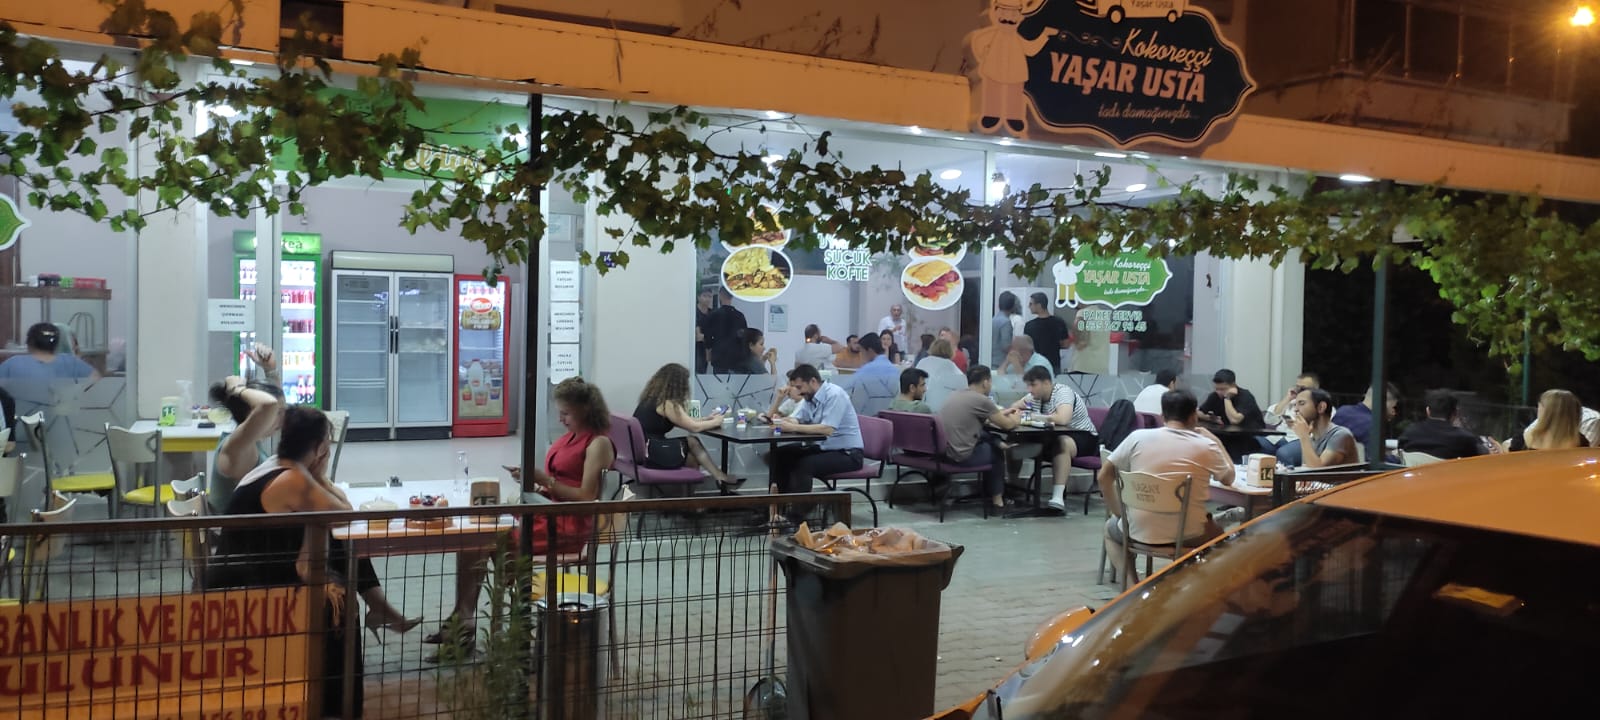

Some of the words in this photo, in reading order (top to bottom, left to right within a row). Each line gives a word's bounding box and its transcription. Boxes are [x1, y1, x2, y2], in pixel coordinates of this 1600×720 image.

[1121, 28, 1213, 72] Kokoreççi
[1050, 52, 1135, 95] YAŞAR
[1142, 66, 1206, 103] USTA
[824, 250, 872, 266] SUCUK
[827, 265, 869, 281] KÖFTE
[1083, 269, 1120, 287] YAŞAR
[1122, 271, 1151, 285] USTA
[1262, 468, 1274, 480] 14
[136, 604, 177, 644] VE
[188, 594, 298, 641] ADAKLIK
